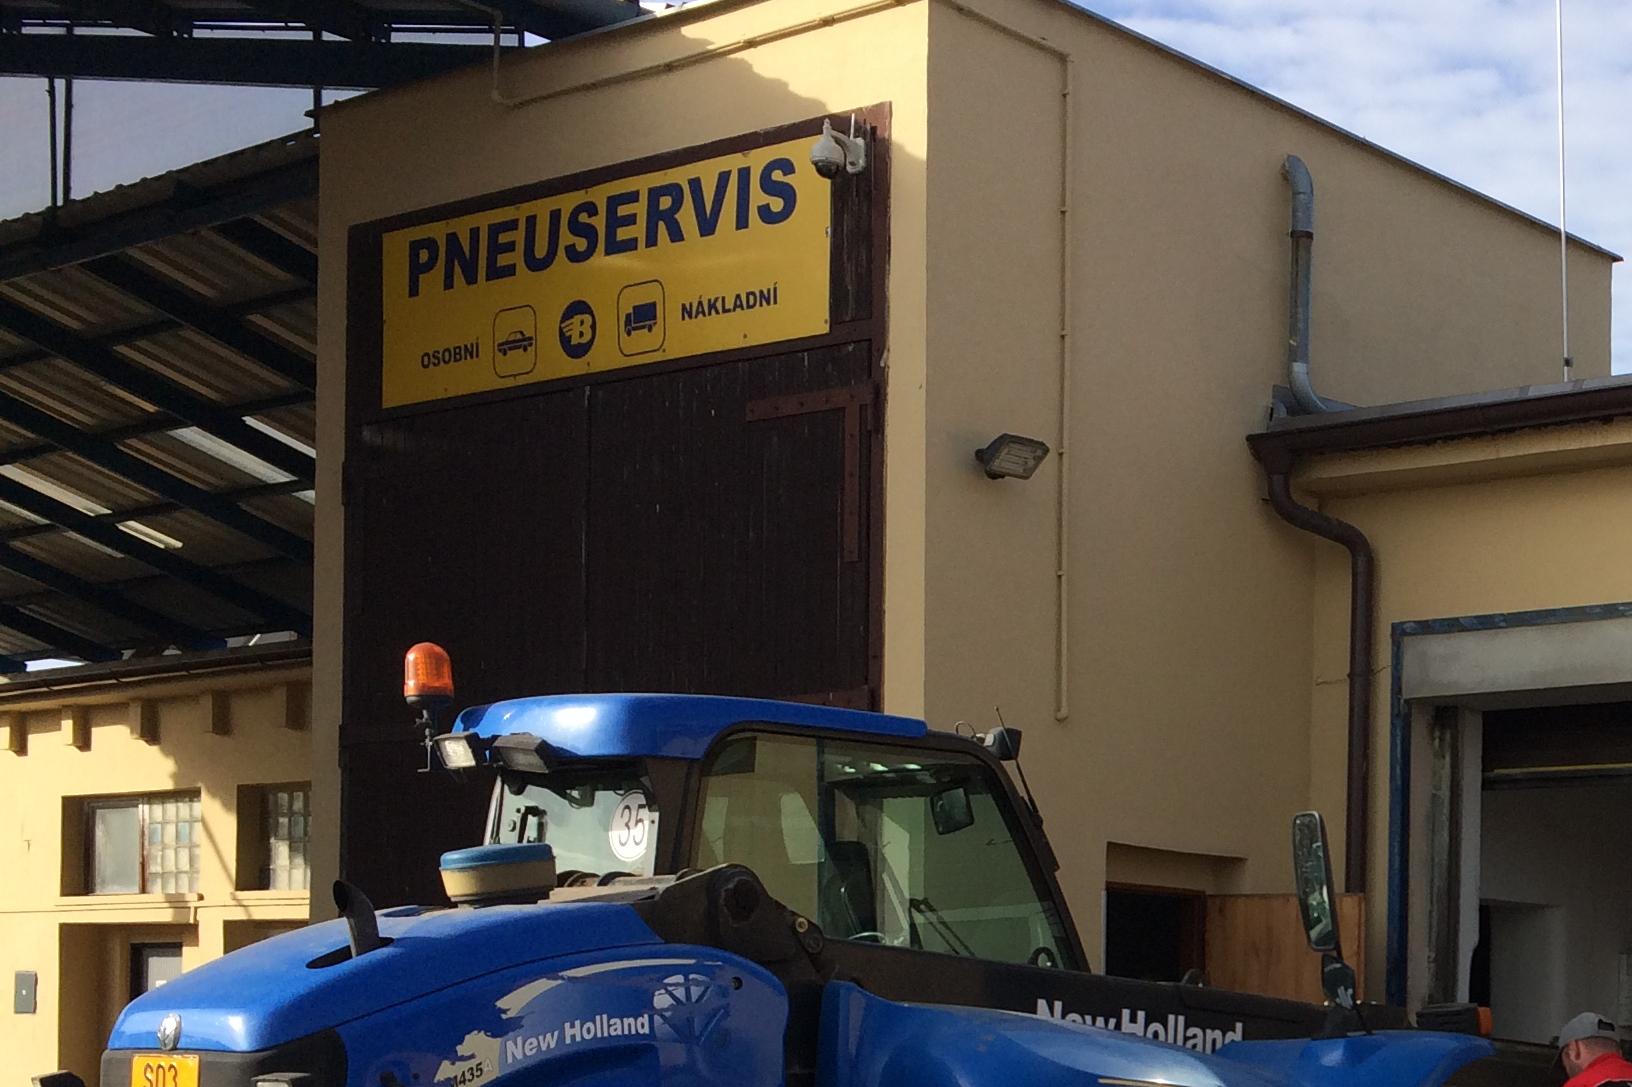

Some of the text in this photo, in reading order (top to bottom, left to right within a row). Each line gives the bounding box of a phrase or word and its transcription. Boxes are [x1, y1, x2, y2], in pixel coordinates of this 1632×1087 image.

[408, 157, 797, 298] PNEUSERVIS
[420, 337, 480, 369] OSOBNÍ
[681, 281, 778, 321] NÁKLADNÍ
[618, 803, 647, 847] 35
[505, 1013, 650, 1065] New Holland
